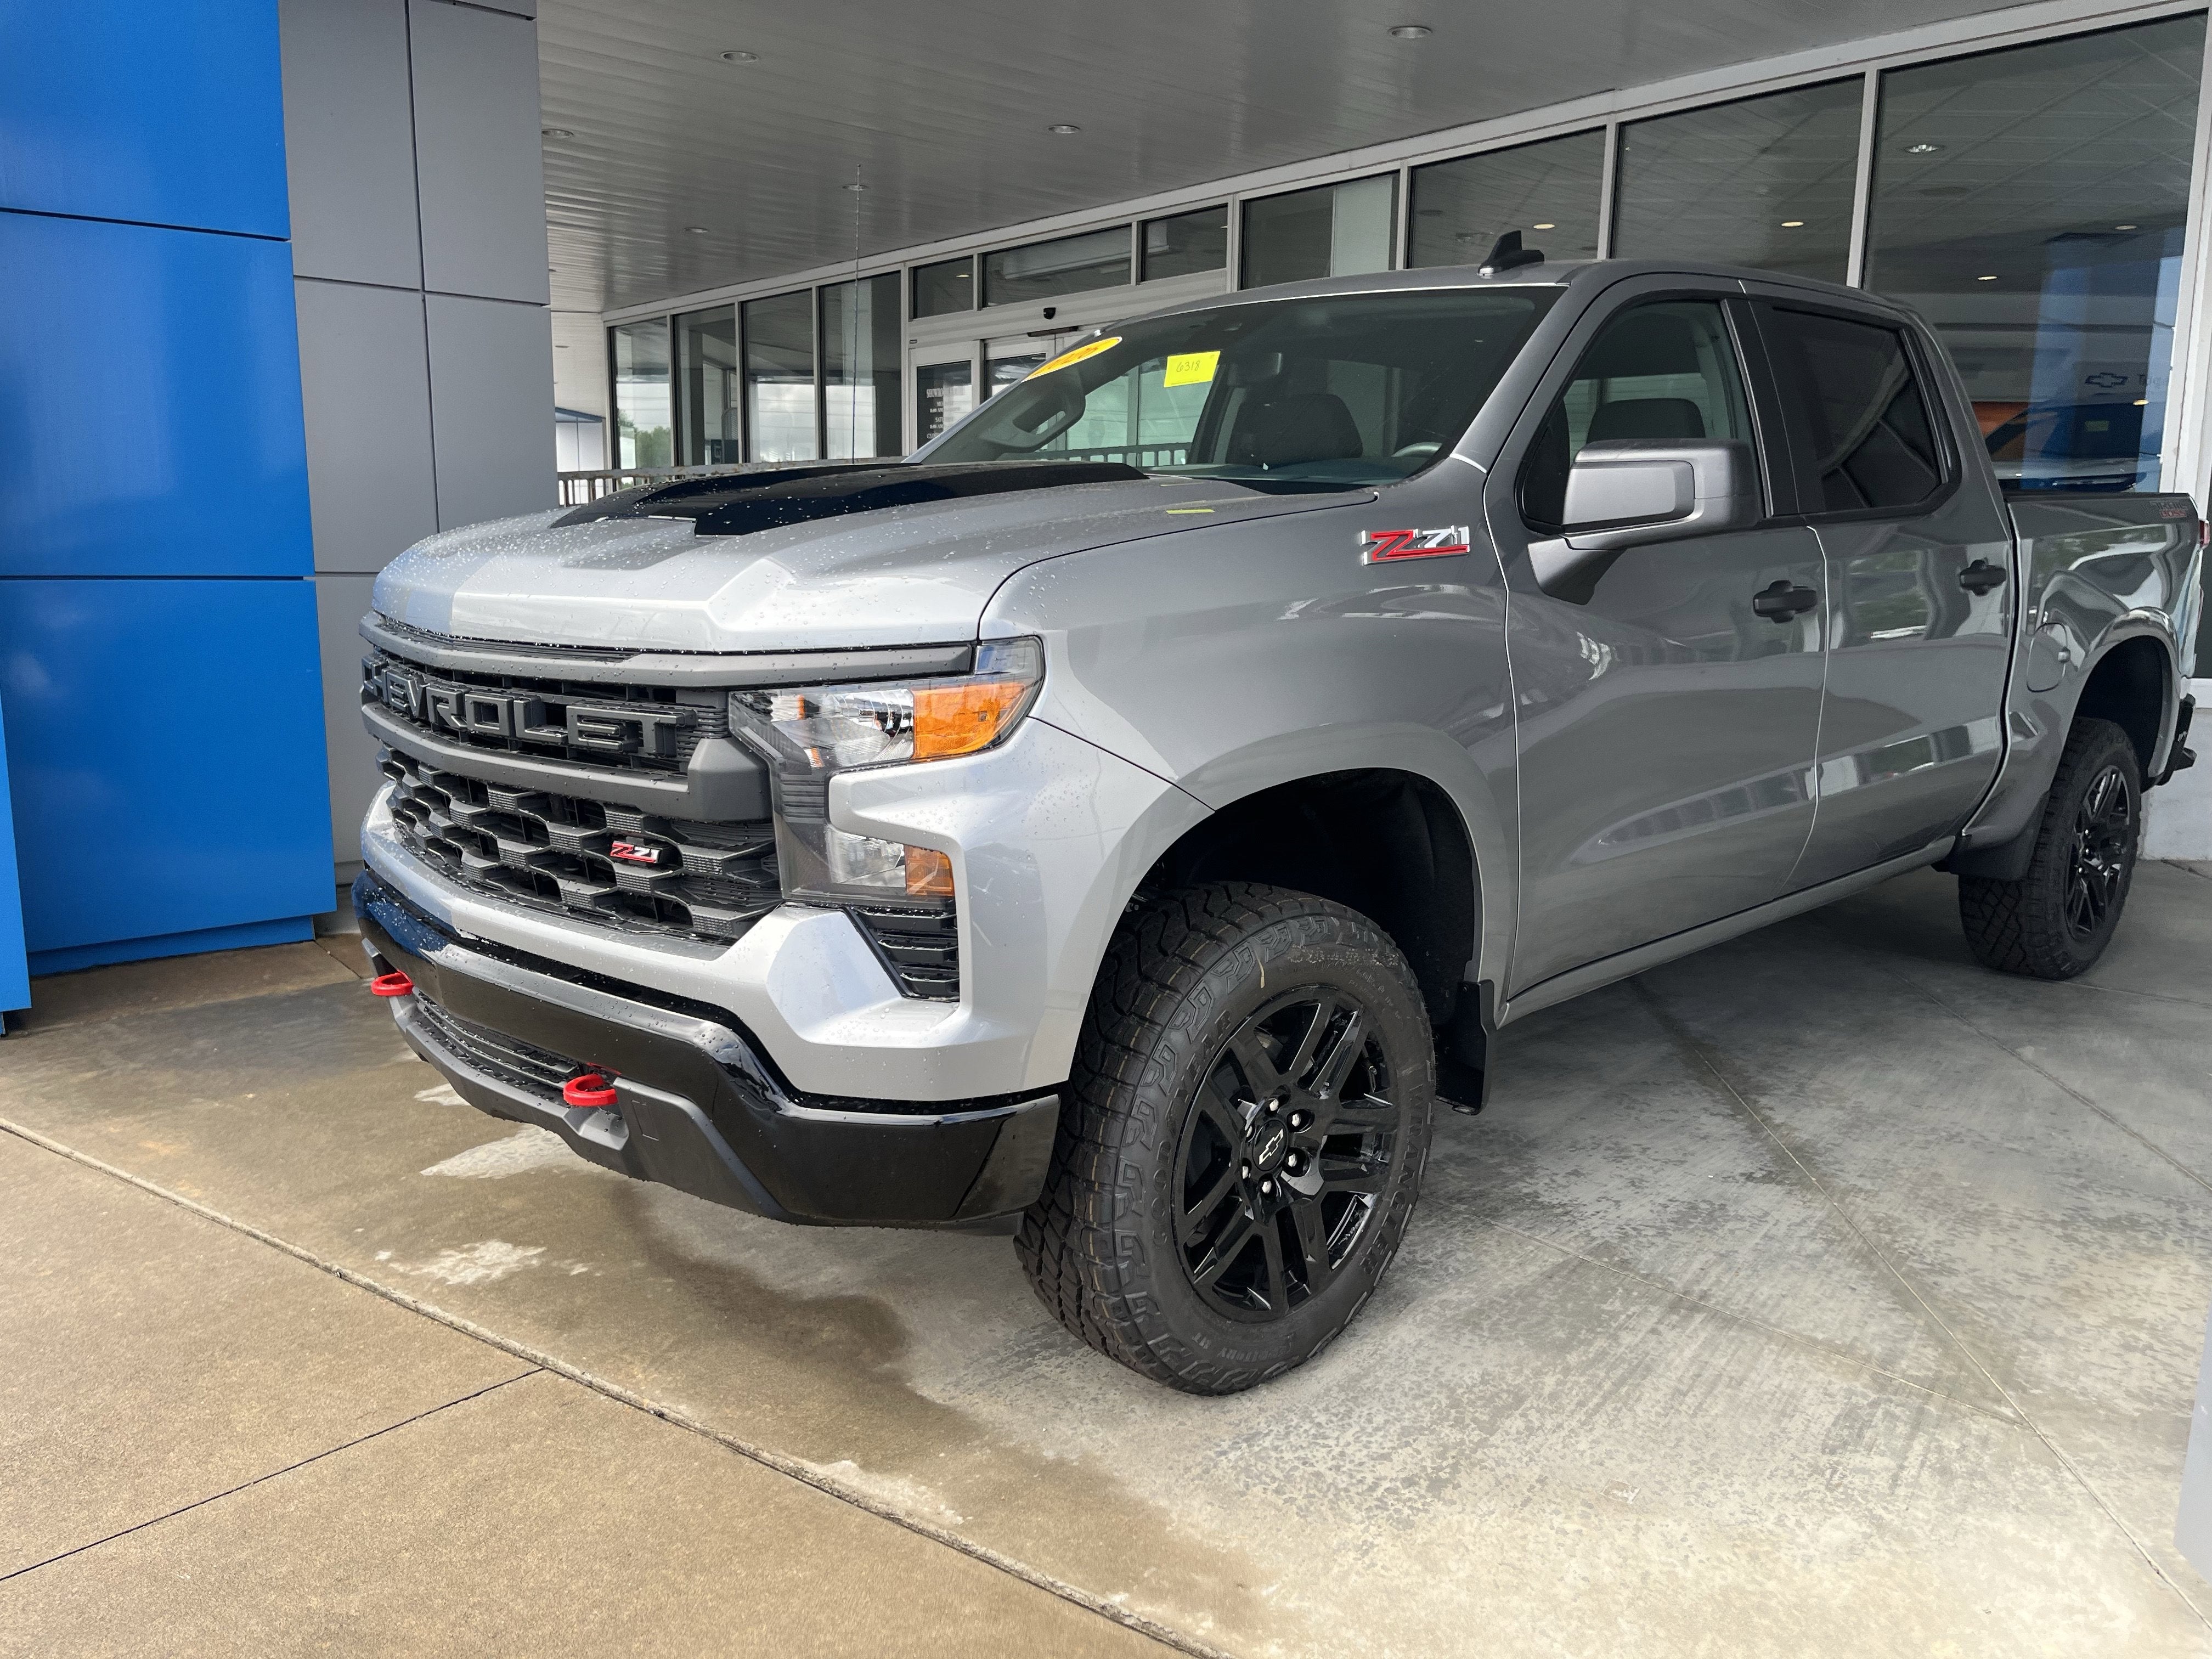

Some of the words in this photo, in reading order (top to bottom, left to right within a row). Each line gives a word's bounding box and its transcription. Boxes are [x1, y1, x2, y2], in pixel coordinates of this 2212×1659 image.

[1176, 360, 1201, 373] 6318
[1361, 525, 1470, 566] Z71
[362, 657, 692, 758] CHEVROLET
[610, 840, 660, 863] Z71
